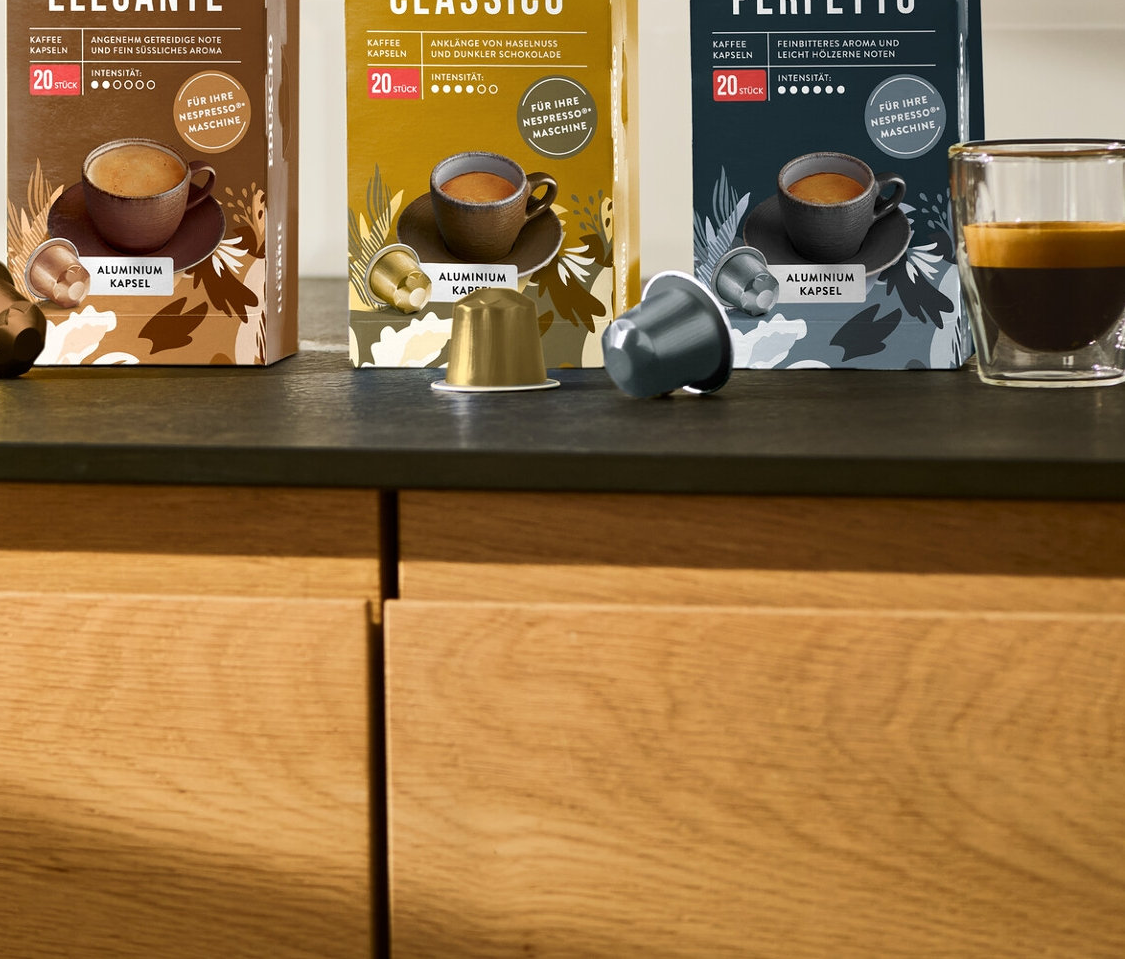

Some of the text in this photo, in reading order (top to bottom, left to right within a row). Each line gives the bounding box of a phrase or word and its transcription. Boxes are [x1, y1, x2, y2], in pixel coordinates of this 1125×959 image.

[144, 36, 195, 44] GETREIDIGE
[367, 39, 400, 47] KAFFEE
[431, 38, 479, 47] ANKLÄNGE
[879, 39, 899, 47] UND
[136, 45, 188, 54] SÜSSLICHES
[431, 50, 562, 58] UND DUNKLER SCHOKOLADE
[778, 50, 809, 58] LEICHT
[812, 49, 861, 58] HÖLZERNE
[713, 51, 753, 59] KAPSELN
[91, 68, 142, 77] INTENSITÄT:
[431, 72, 484, 81] INTENSITÄT:
[34, 70, 78, 90] 20 STÜCK
[778, 73, 831, 82] INTENSITÄT:
[371, 73, 417, 93] 20 STÜCK
[717, 75, 763, 96] 20 STÜCK
[187, 92, 234, 107] FÜR IHRE
[531, 96, 579, 112] FÜR IHRE
[879, 95, 928, 112] FÜR IHRE
[188, 116, 241, 133] MASCHINE
[880, 120, 936, 138] MASCHINE
[532, 121, 587, 139] MASCHINE
[97, 266, 163, 275] ALUMINIUM
[439, 272, 506, 282] ALUMINIUM
[787, 274, 854, 282] ALUMINIUM
[110, 279, 150, 288] KAPSEL
[800, 287, 842, 295] KAPSEL
